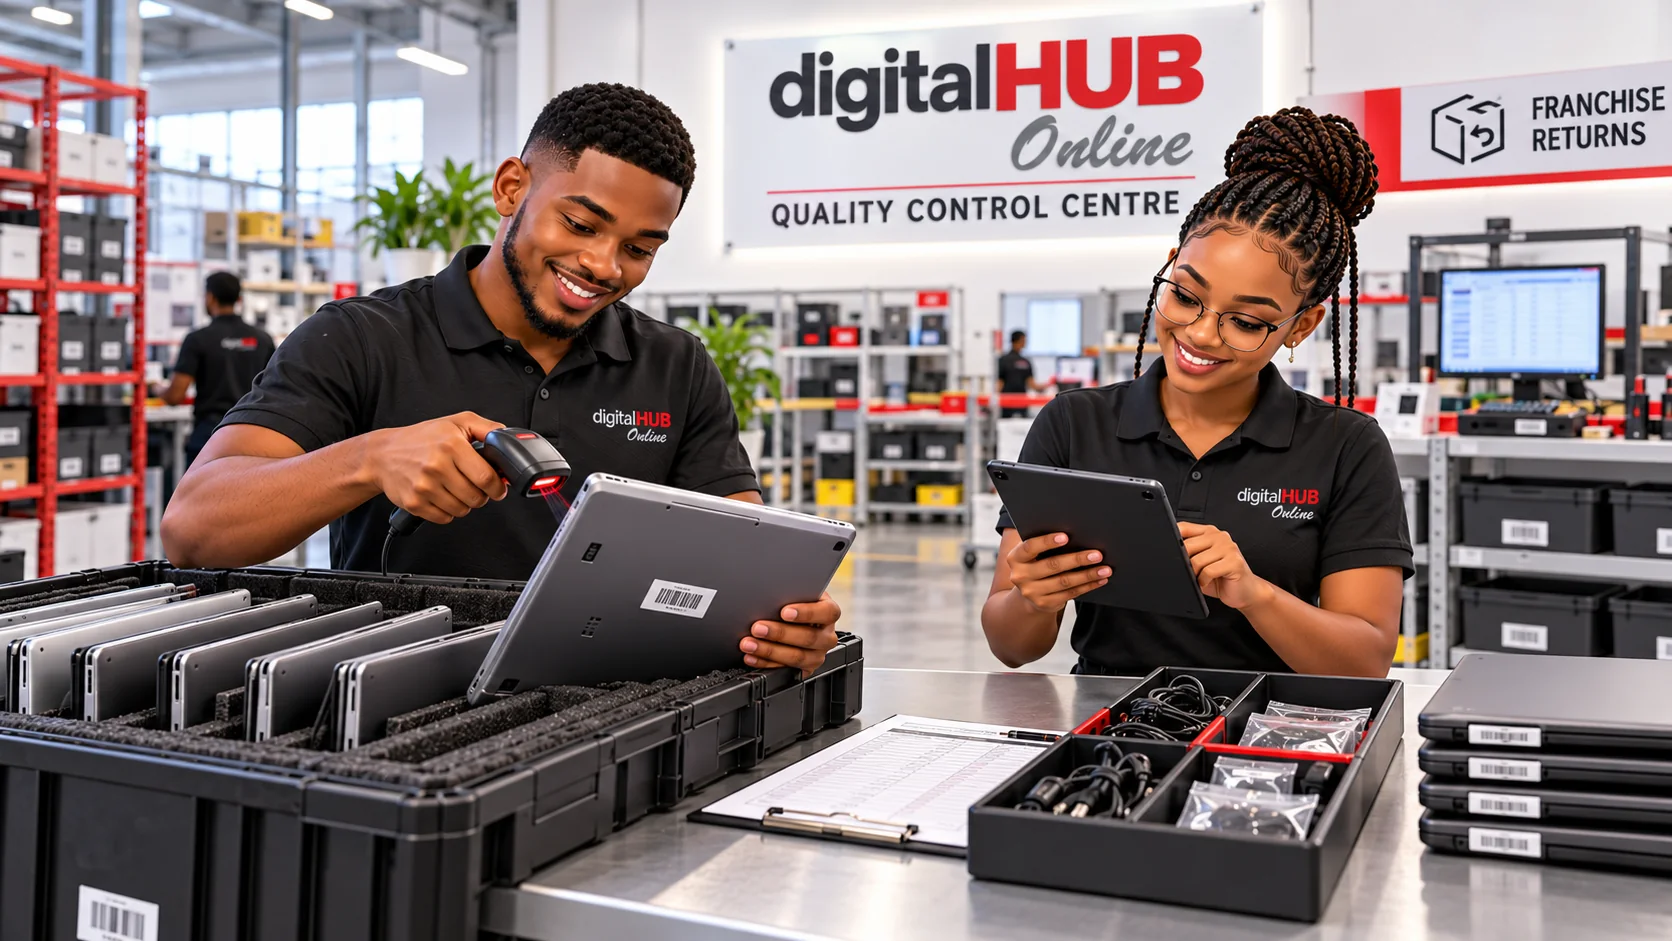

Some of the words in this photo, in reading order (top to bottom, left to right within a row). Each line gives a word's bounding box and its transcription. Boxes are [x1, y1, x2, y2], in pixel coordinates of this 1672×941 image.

[770, 34, 1204, 133] digitalHUB
[1532, 86, 1666, 119] FRANCHISE
[1011, 115, 1194, 171] Online
[1532, 121, 1647, 151] RETURNS
[771, 200, 894, 228] QUALITY
[907, 194, 1048, 222] CONTROL
[1061, 190, 1180, 217] CENTRE
[592, 408, 672, 428] digitalHUB
[626, 427, 668, 443] Online
[1237, 487, 1320, 506] digitalHUB
[1271, 505, 1314, 520] Online
